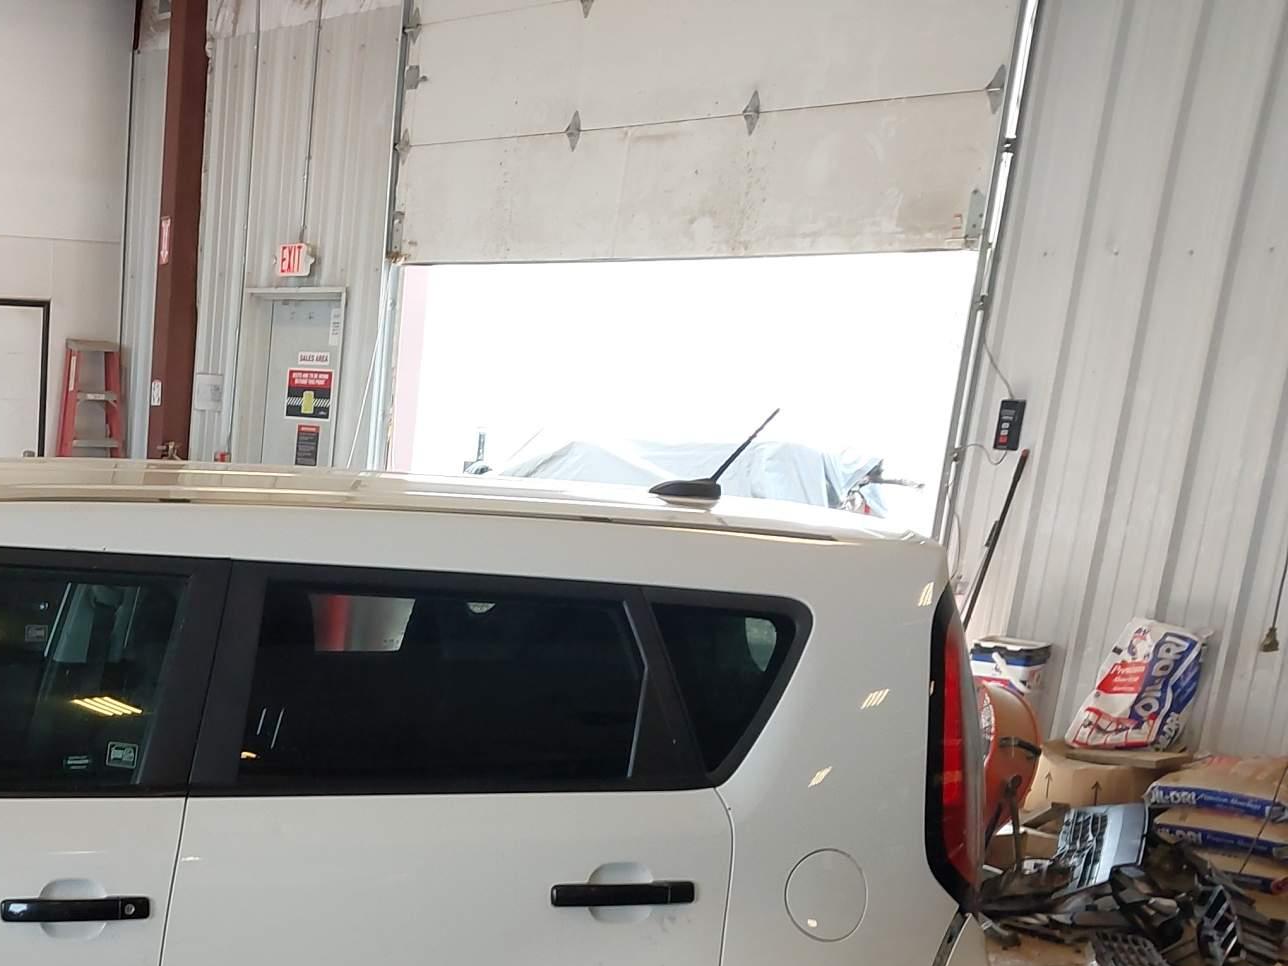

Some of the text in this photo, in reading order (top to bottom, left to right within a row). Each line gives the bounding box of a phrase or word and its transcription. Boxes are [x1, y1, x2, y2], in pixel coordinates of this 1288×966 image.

[280, 245, 303, 273] EXIT
[299, 353, 329, 362] SALES AREA
